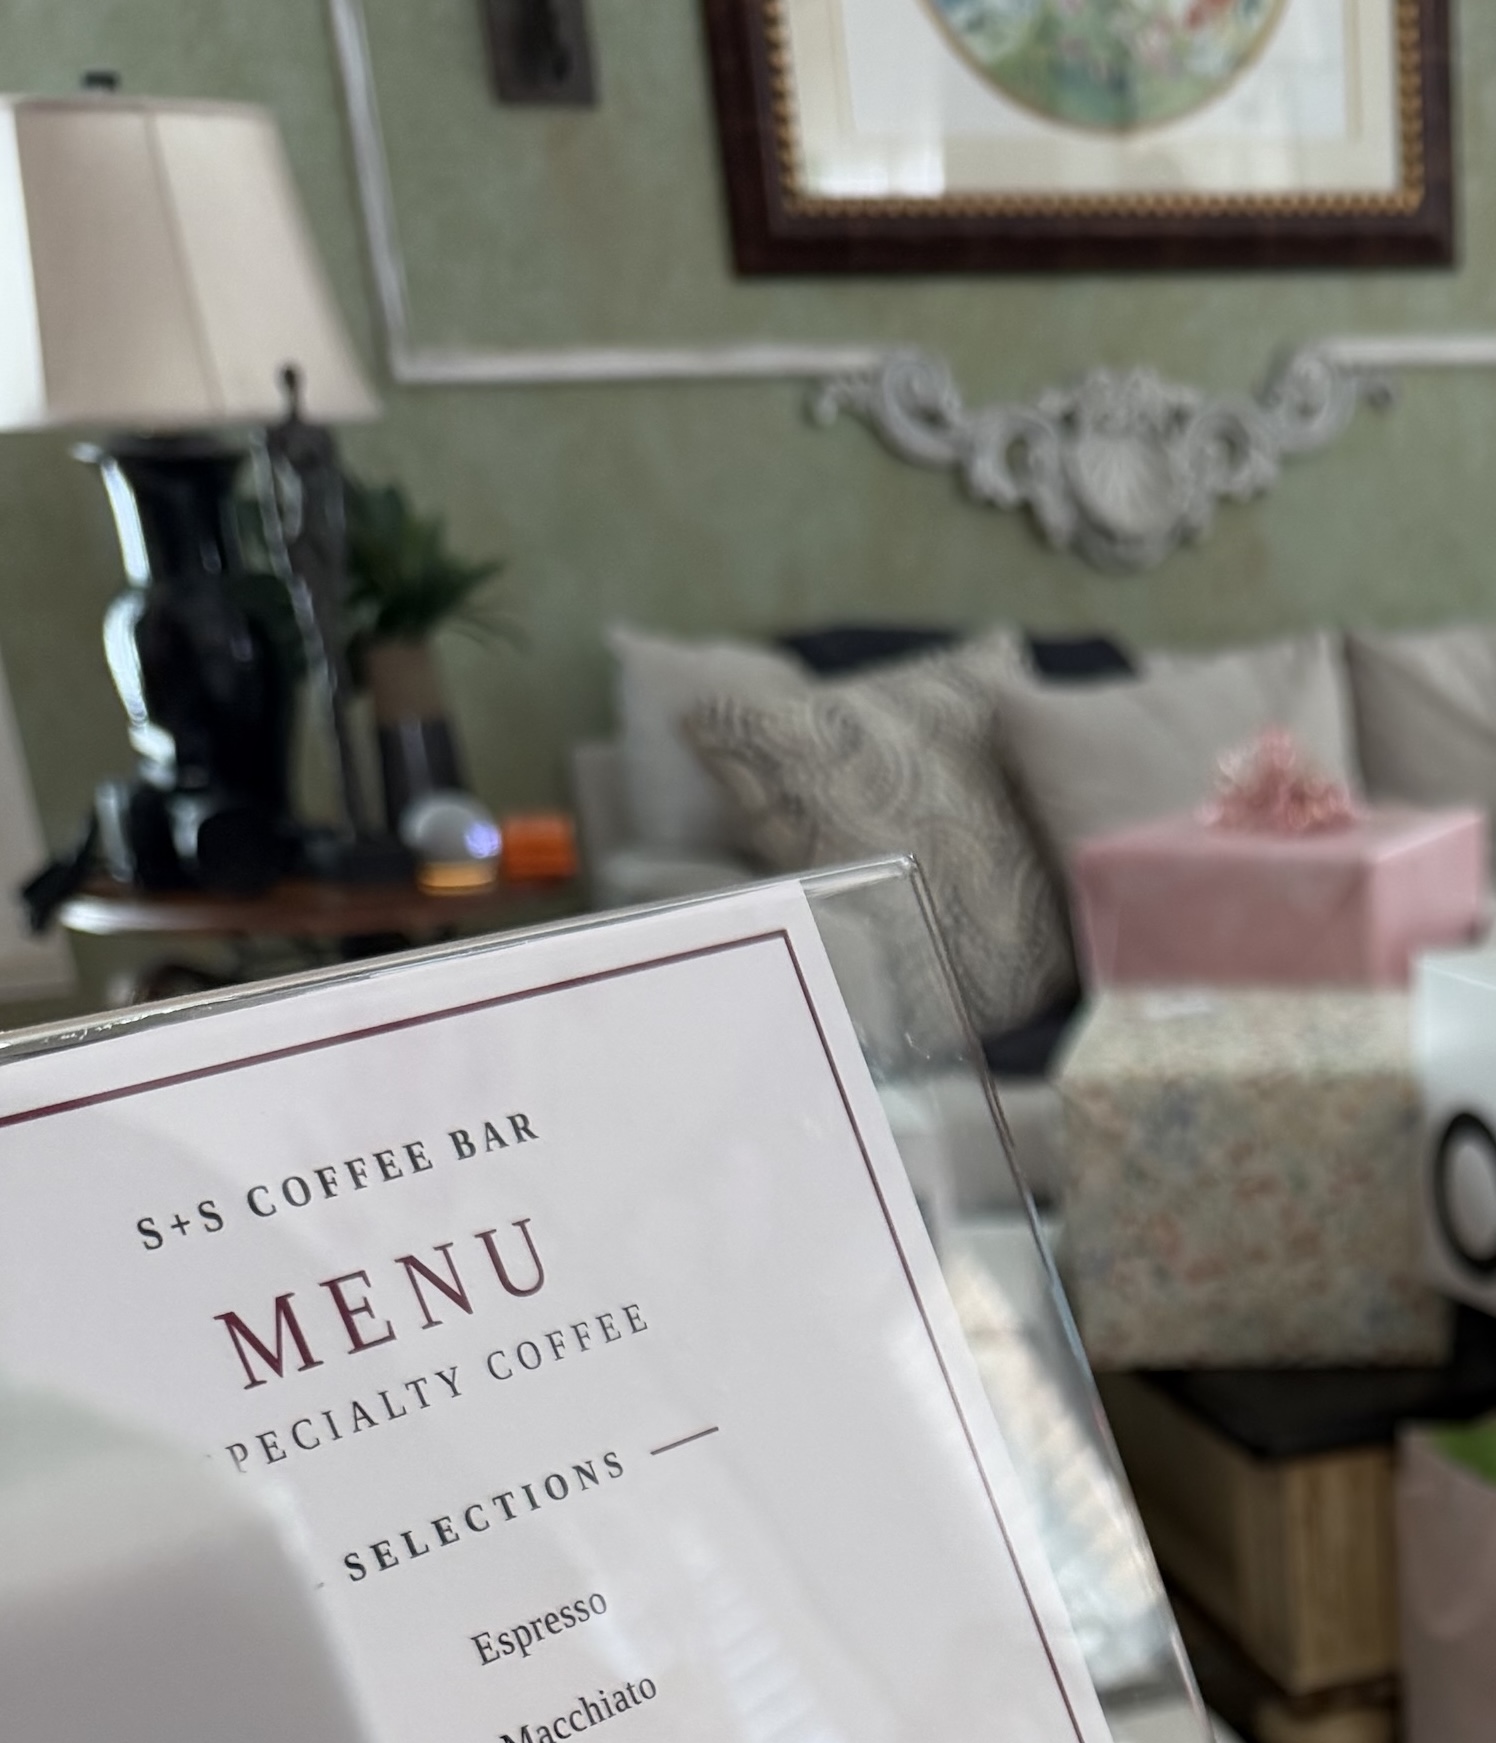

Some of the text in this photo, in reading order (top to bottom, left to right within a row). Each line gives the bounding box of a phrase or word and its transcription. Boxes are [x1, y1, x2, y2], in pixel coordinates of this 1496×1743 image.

[136, 1111, 540, 1251] S+S COFFEE BAR
[213, 1217, 547, 1390] MENU
[206, 1303, 649, 1474] PECIALTY COFFEE
[343, 1451, 625, 1582] SELECTIONS
[470, 1592, 608, 1666] Espresso
